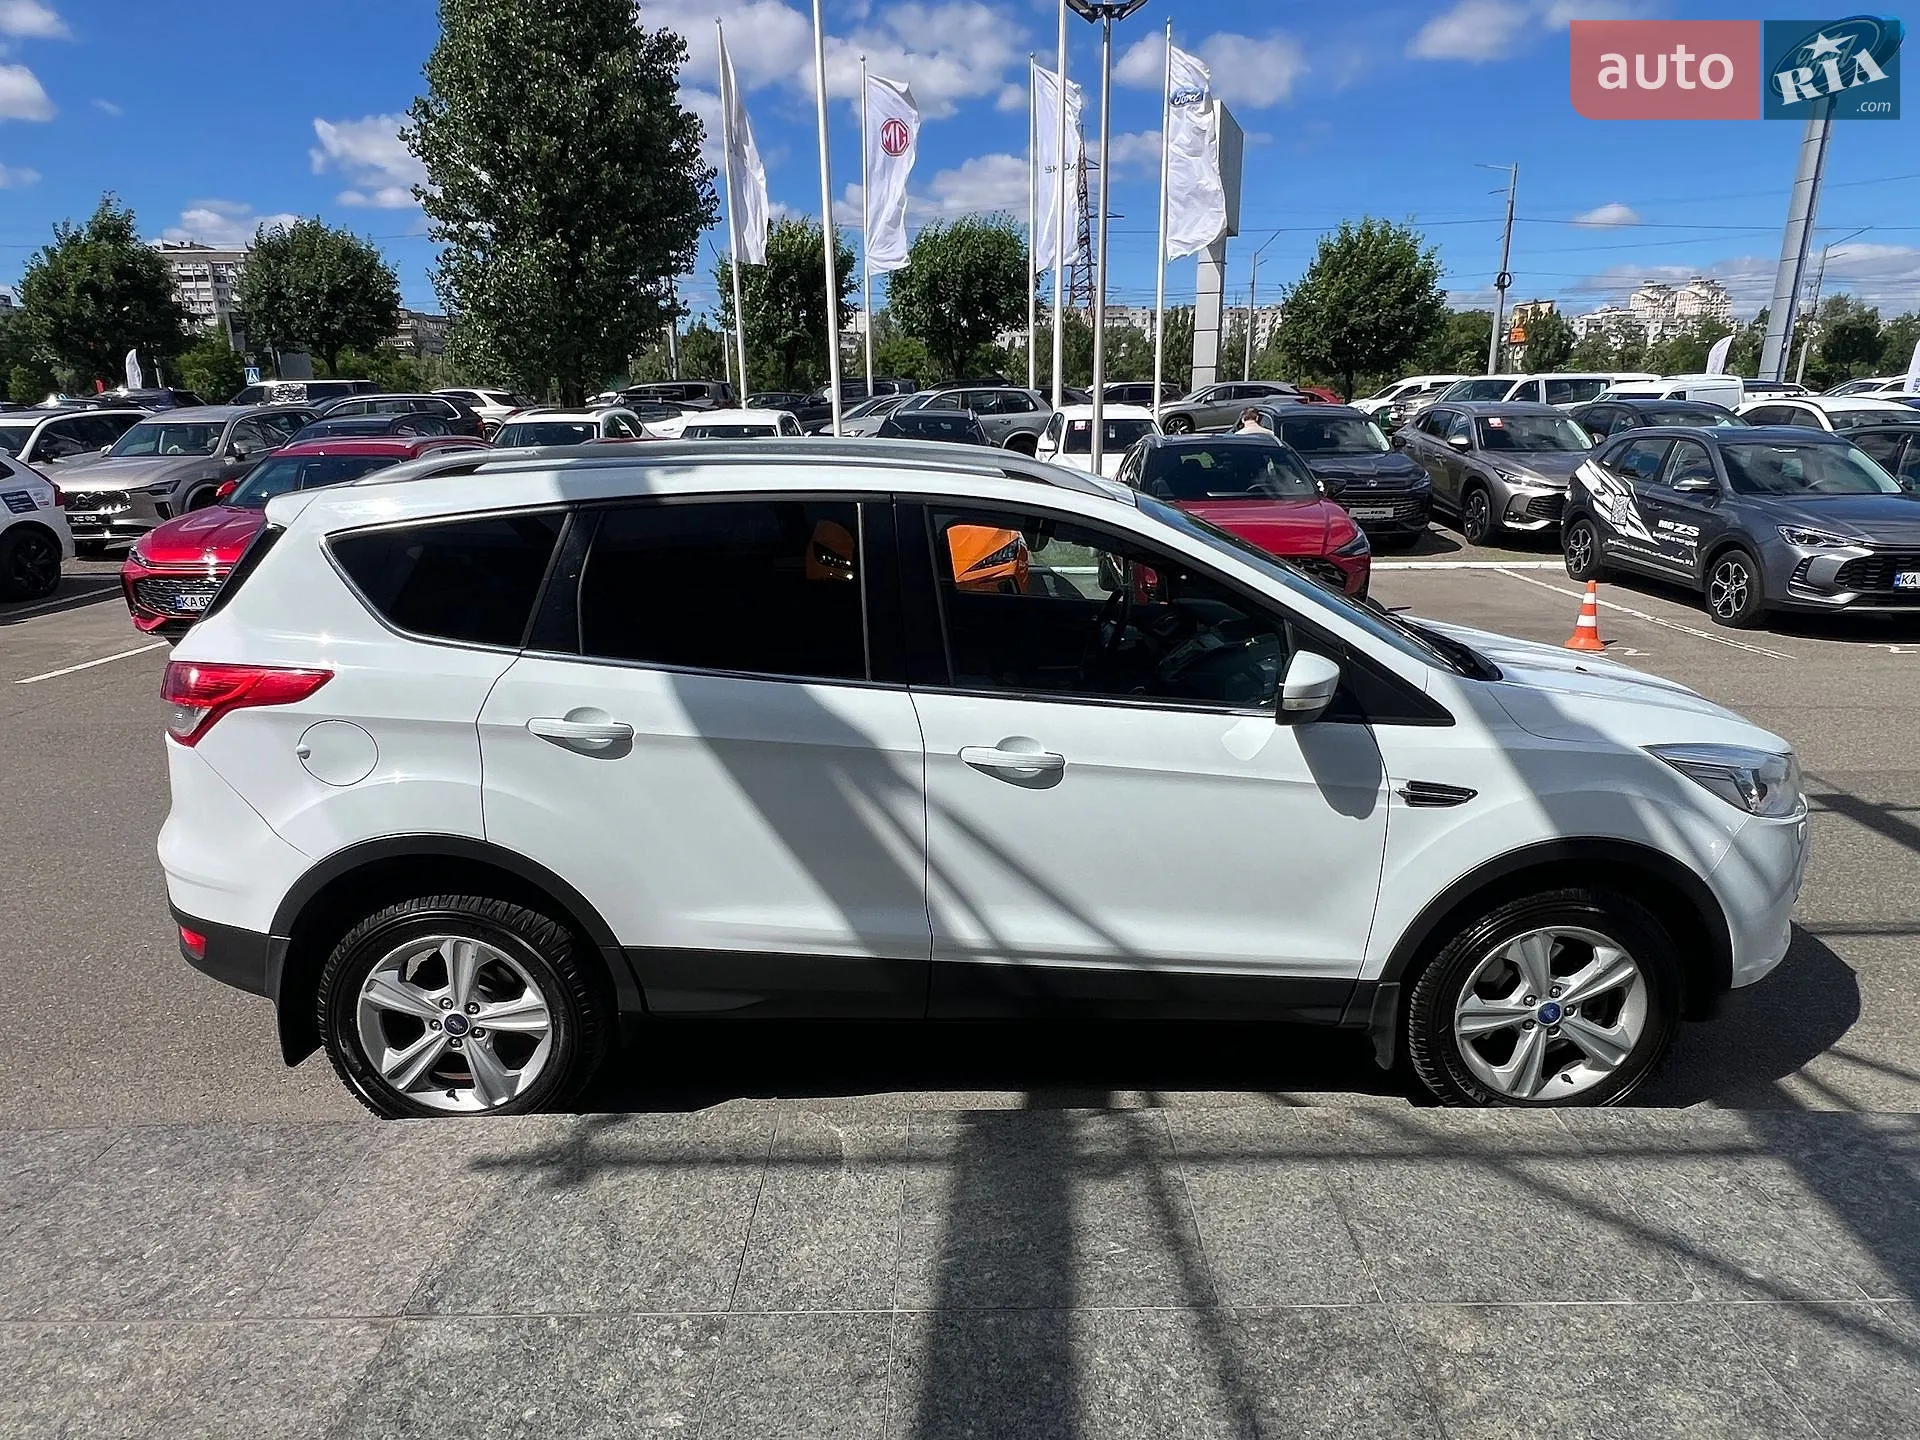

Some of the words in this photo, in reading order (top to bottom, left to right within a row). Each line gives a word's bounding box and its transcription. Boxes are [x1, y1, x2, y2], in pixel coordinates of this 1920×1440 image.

[1173, 90, 1201, 105] Ford
[882, 121, 908, 153] MG
[1674, 523, 1700, 537] ZS
[1902, 574, 1917, 585] KA
